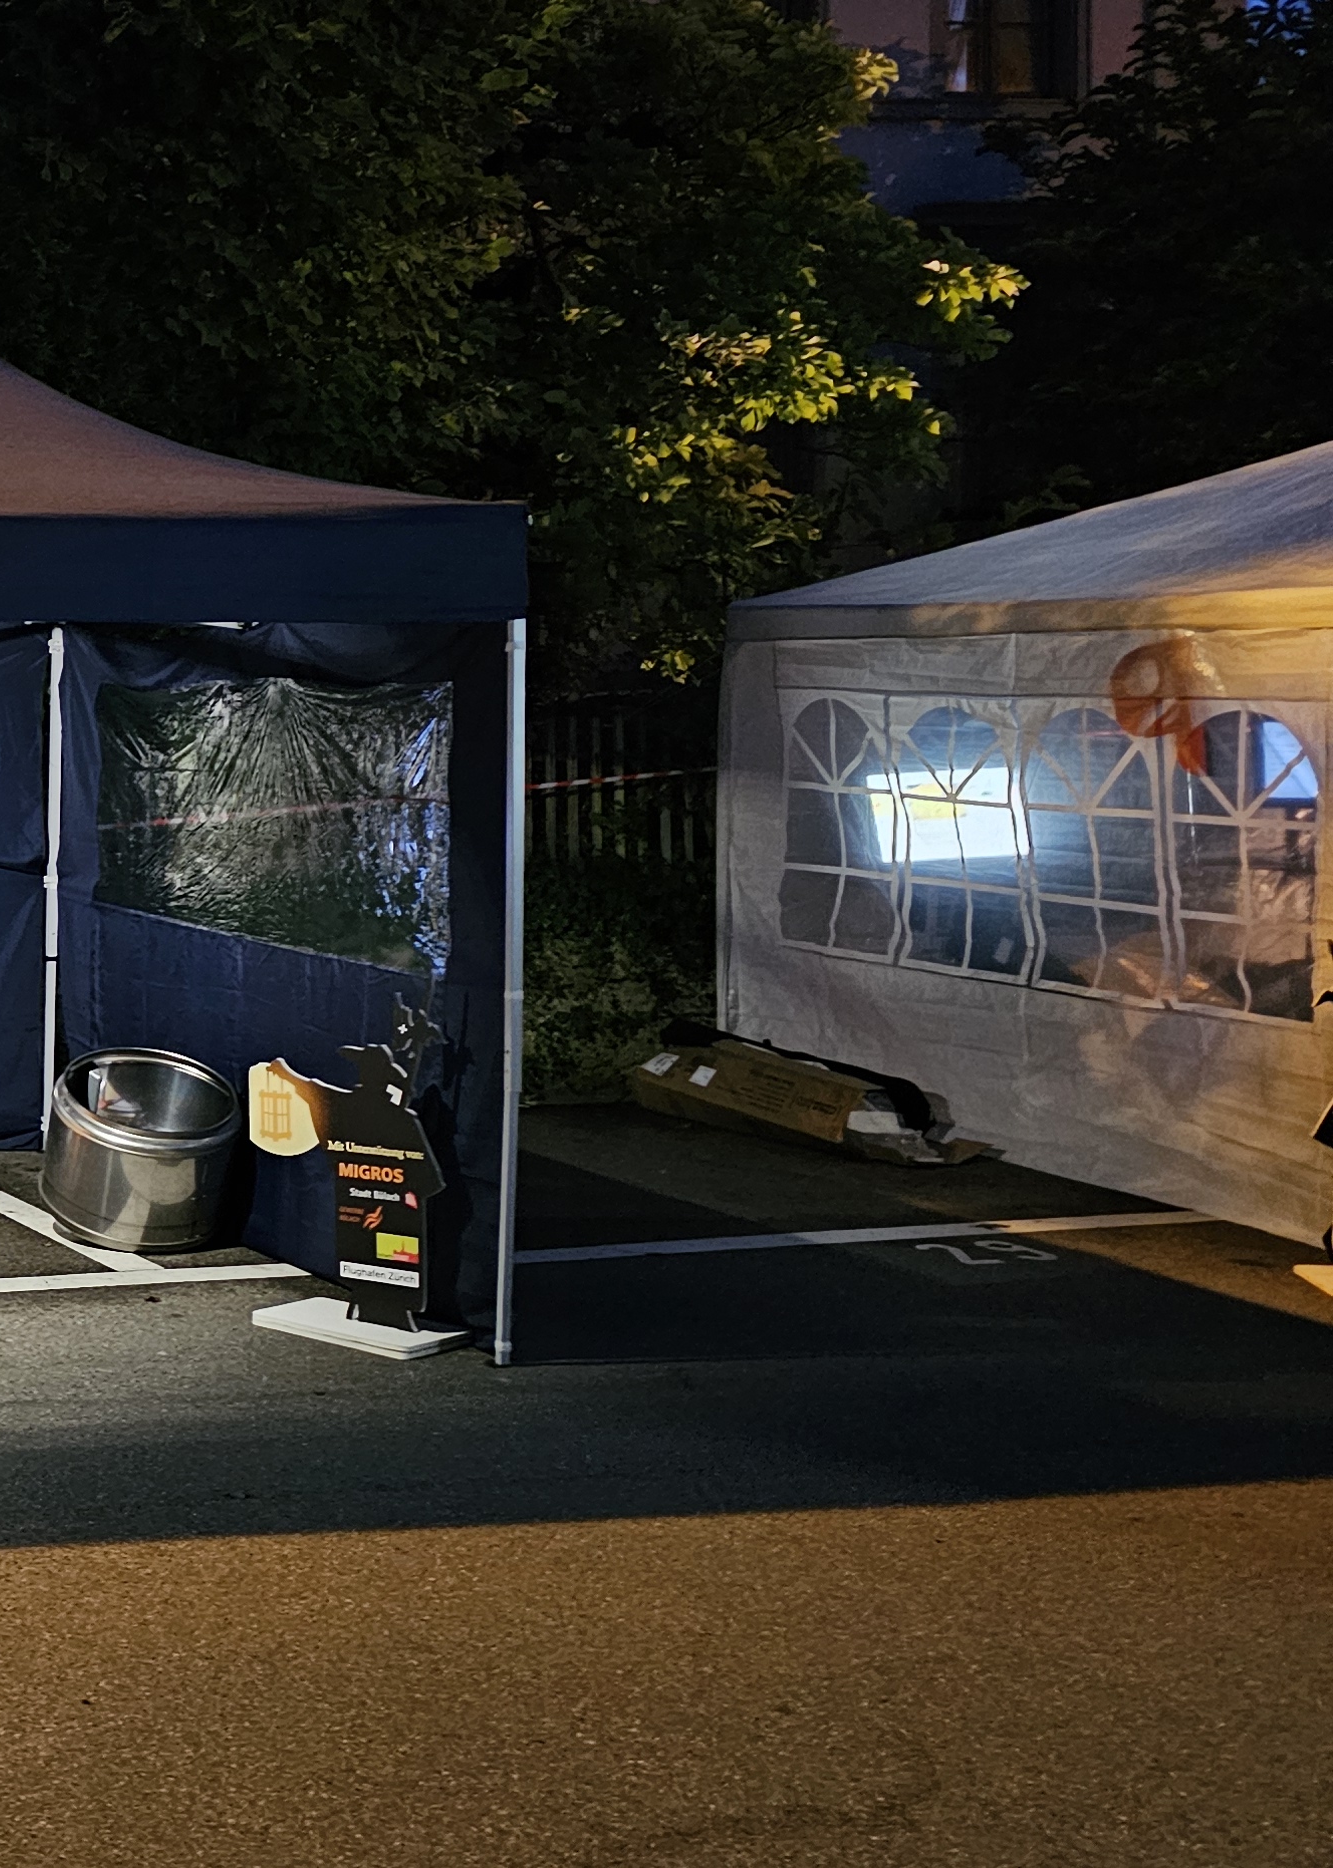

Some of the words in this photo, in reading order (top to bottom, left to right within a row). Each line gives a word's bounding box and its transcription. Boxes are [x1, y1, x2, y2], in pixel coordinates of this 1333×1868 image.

[327, 1140, 345, 1151] Mit
[338, 1162, 405, 1184] MIGROS
[349, 1187, 372, 1199] Stadt
[915, 1240, 1059, 1265] 29
[343, 1265, 387, 1280] Flughafen
[388, 1271, 417, 1284] Zürich
